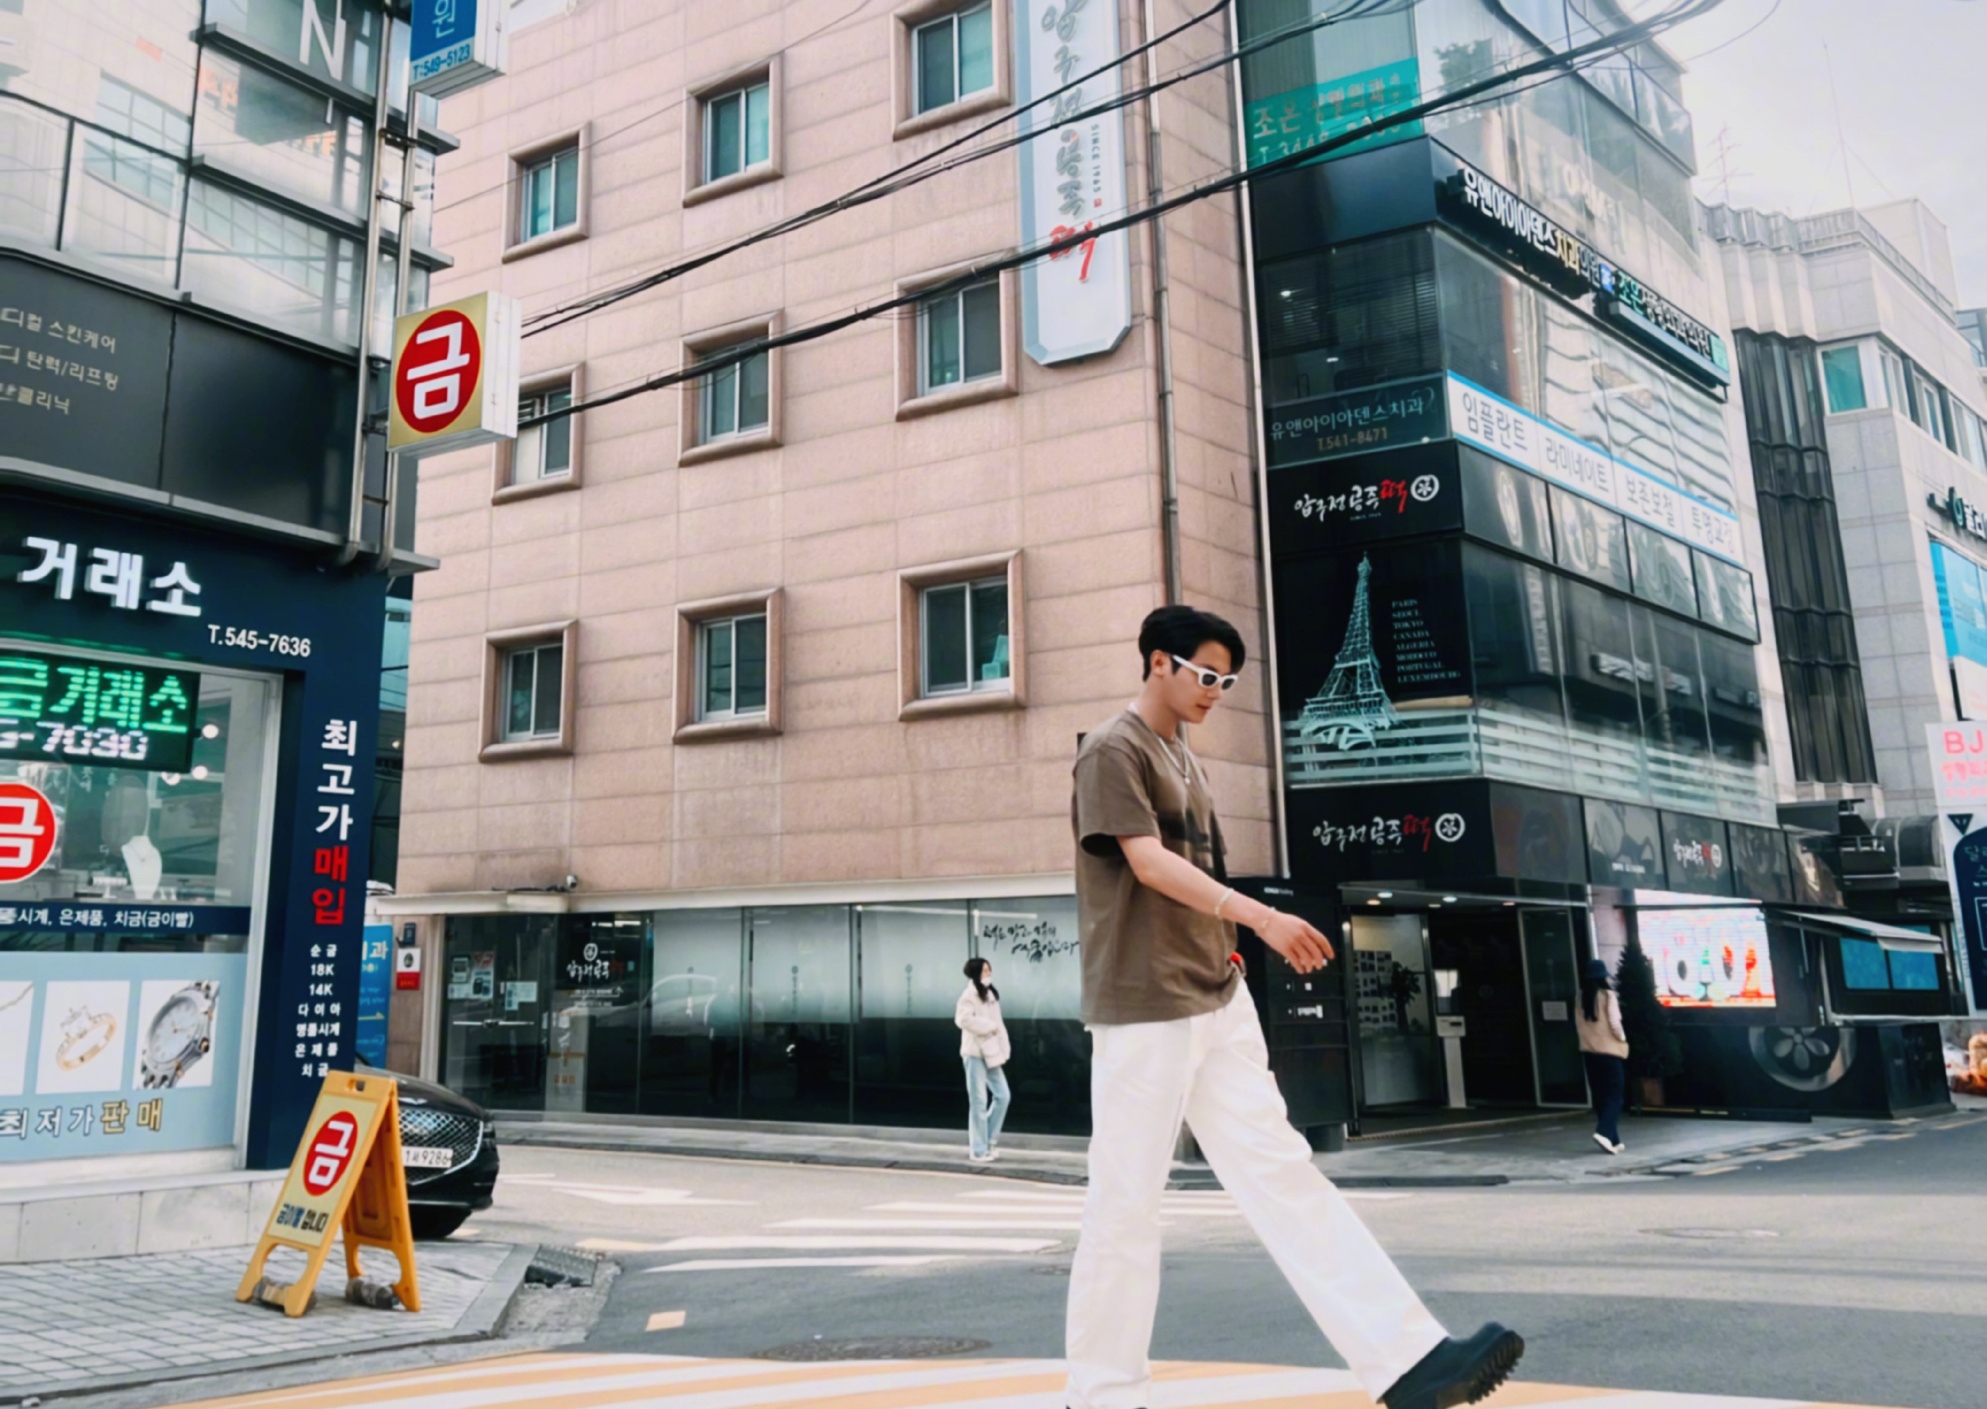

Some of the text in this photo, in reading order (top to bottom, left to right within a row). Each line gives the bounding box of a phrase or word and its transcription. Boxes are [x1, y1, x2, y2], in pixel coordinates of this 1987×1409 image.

[48, 321, 116, 354] 스킨케어
[406, 322, 470, 420] 금
[1270, 396, 1424, 441] 유앤아이아덴스치과
[1462, 392, 1528, 451] 임플란트
[1545, 437, 1610, 493] 라미네이트
[16, 536, 202, 618] 거래소
[208, 624, 312, 657] T.545-7636
[1943, 729, 1984, 754] BJ
[310, 963, 335, 977] 18K
[309, 983, 333, 997] 14K
[308, 1120, 354, 1187] 금
